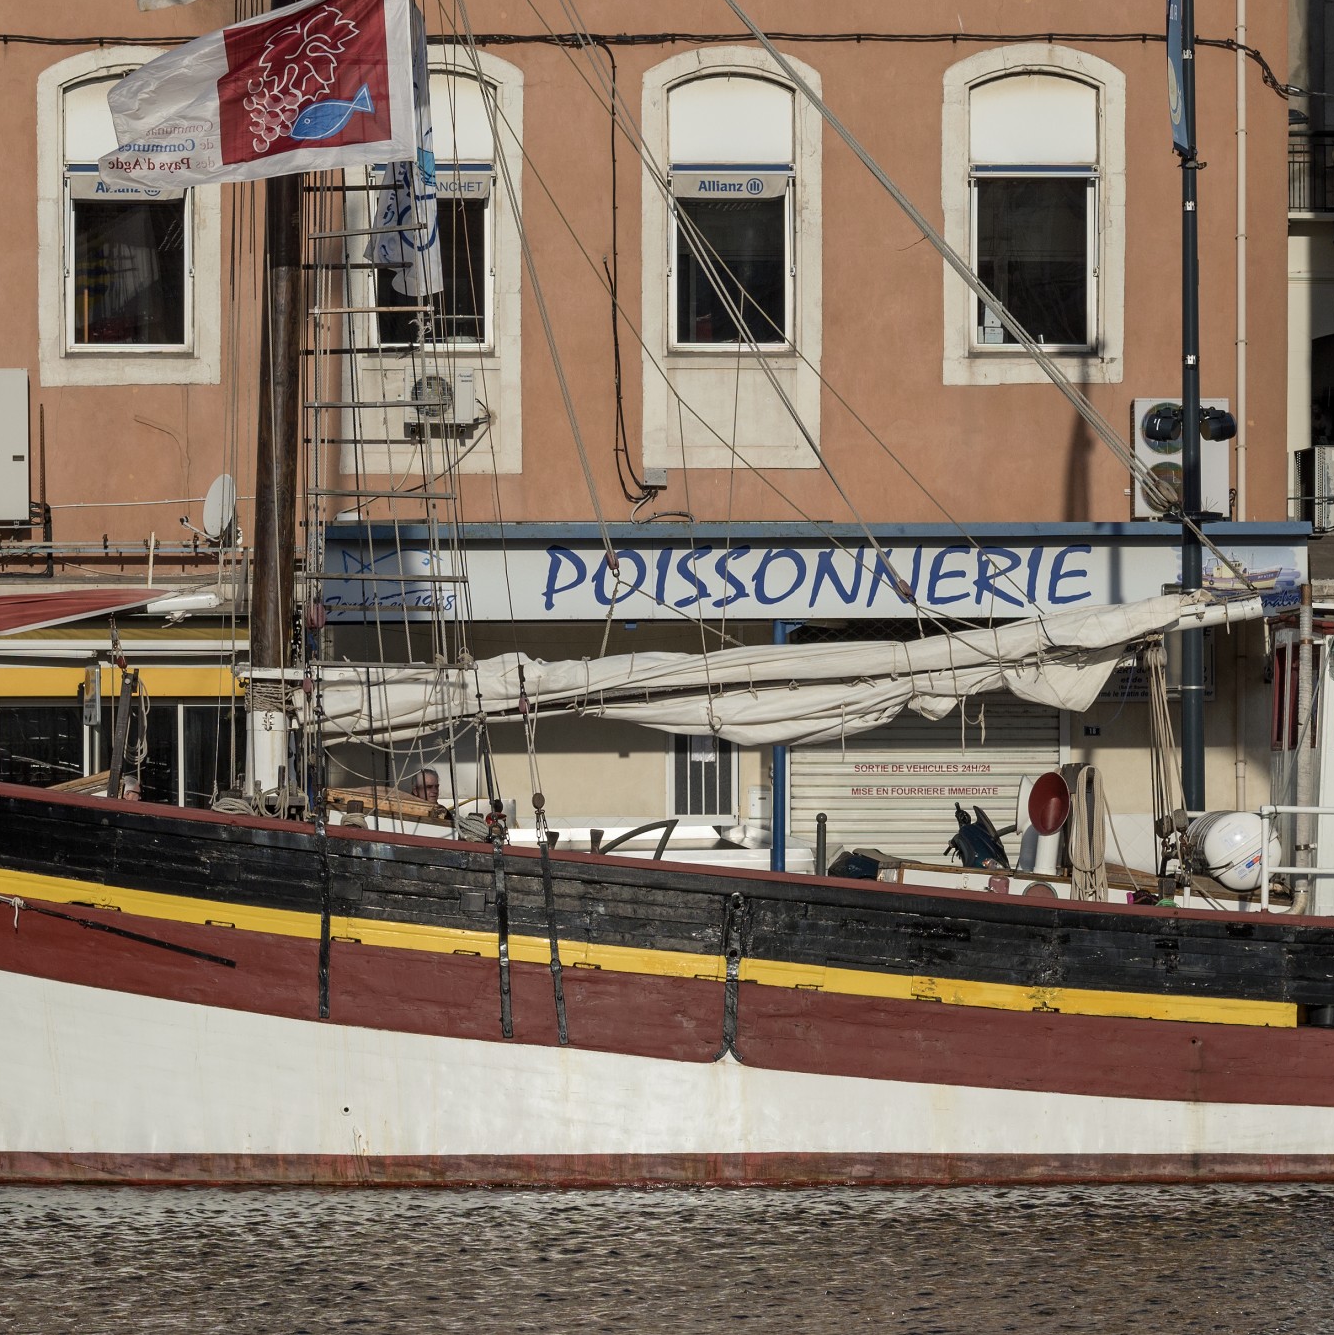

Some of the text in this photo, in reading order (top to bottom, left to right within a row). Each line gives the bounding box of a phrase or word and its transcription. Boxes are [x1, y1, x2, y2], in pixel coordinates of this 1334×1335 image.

[436, 181, 483, 192] ANCHET
[698, 180, 743, 192] Allianz
[541, 544, 1092, 610] POISSONNERIE
[854, 764, 991, 773] SORTIE DE VEHICULES 24H/24
[851, 787, 999, 795] MISE EN FOURRIERE IMMEDIATE
